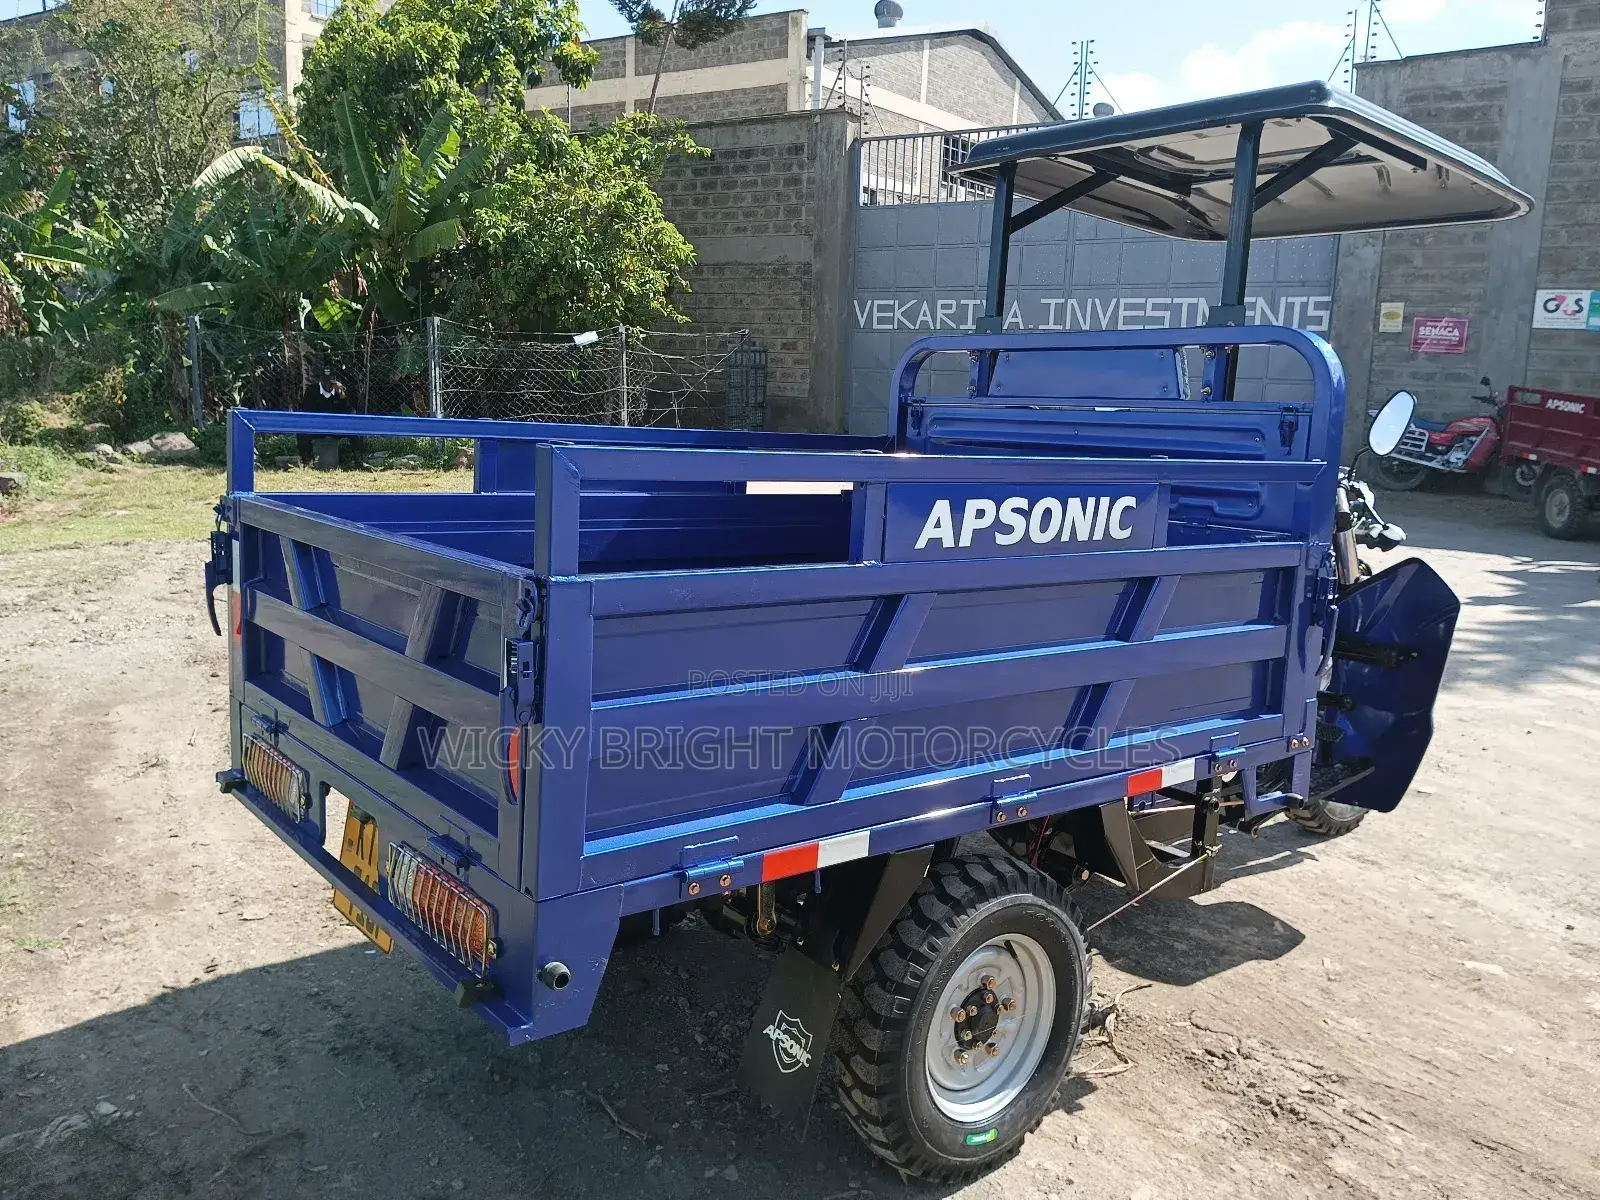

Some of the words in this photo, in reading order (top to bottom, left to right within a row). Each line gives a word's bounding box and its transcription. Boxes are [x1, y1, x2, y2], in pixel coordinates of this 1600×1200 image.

[853, 296, 1332, 331] VEKARIA.INVESTNTS
[1545, 399, 1586, 413] APSONIC
[914, 496, 1137, 549] APSONIC
[762, 1024, 812, 1068] APSONIC
